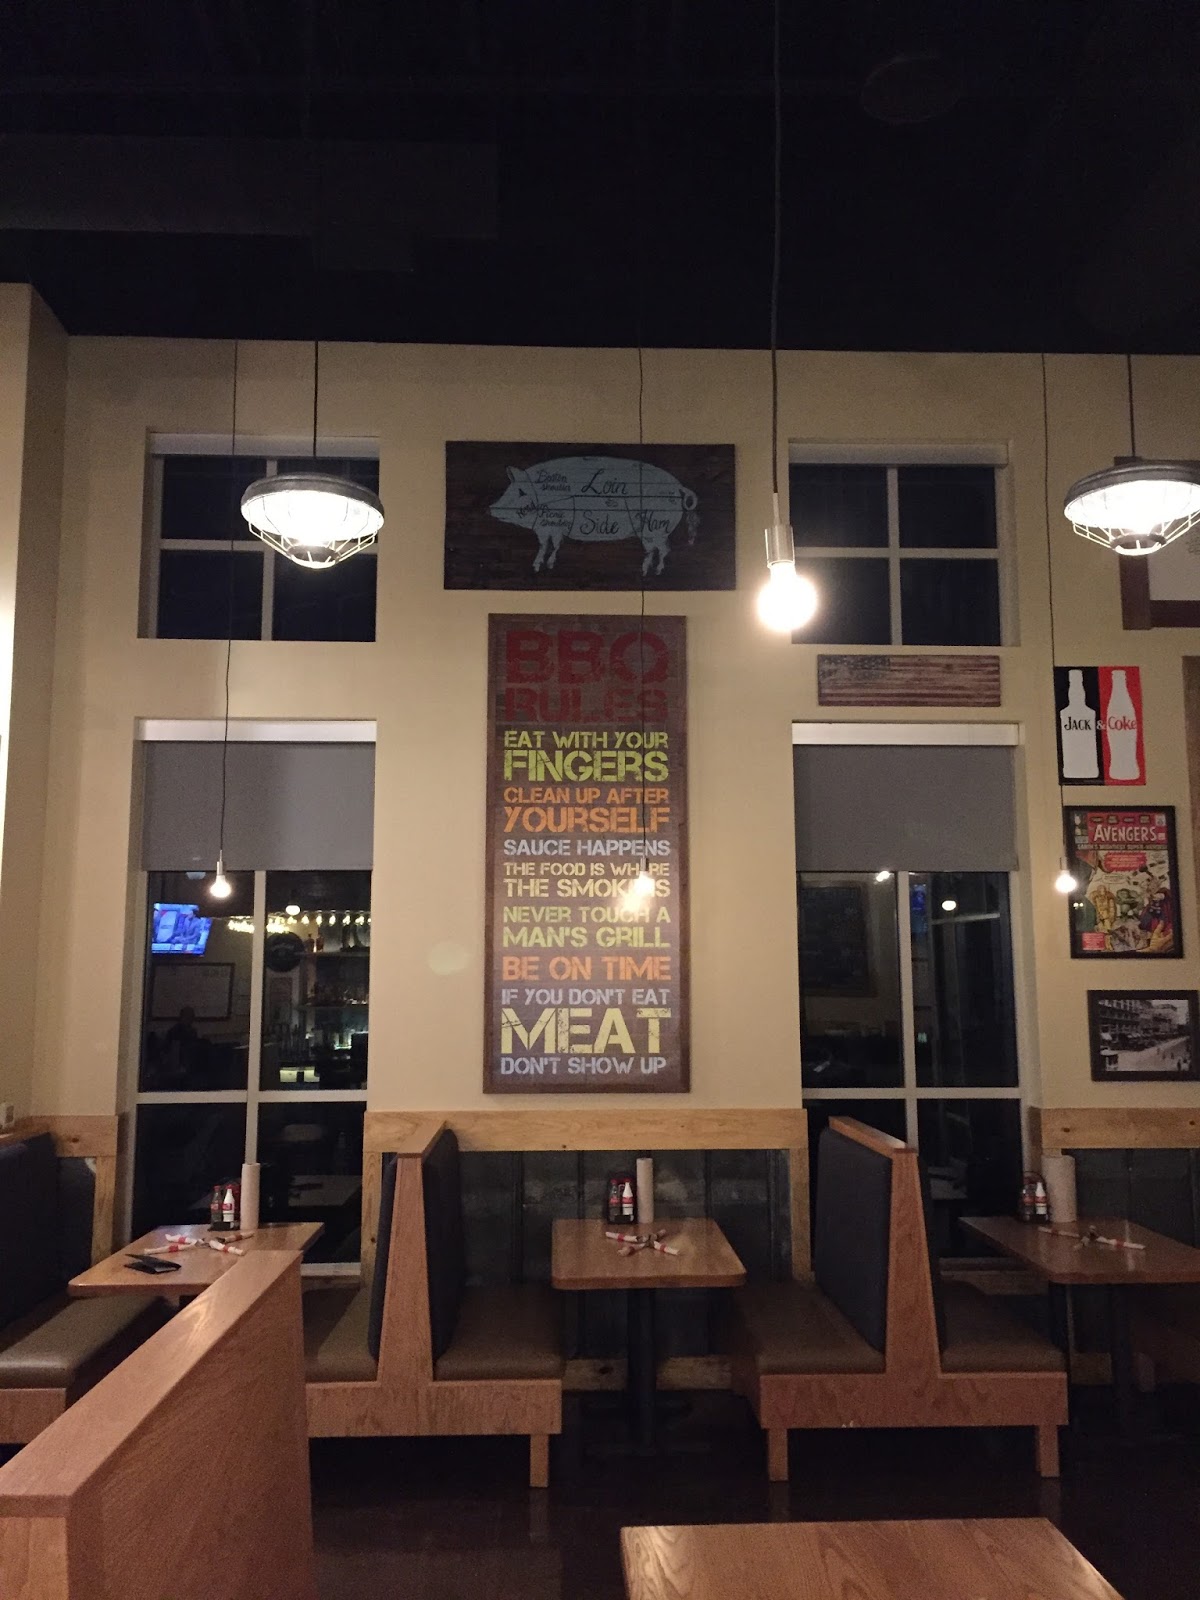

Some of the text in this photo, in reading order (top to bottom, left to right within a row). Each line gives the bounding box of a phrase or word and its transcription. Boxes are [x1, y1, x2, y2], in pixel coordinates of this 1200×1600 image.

[581, 468, 627, 494] Loin
[580, 510, 619, 535] Side
[635, 509, 670, 533] Ham
[506, 630, 669, 684] BBQ
[505, 687, 669, 722] RULES
[1064, 716, 1092, 731] JACK
[1108, 715, 1137, 731] Coke
[504, 731, 669, 749] EAT WITH YOUR
[504, 750, 669, 782] FINGERS
[503, 787, 669, 804] CLEAN UP AFTER
[503, 806, 671, 833] YOURSELF
[1093, 824, 1157, 842] AVENGERS
[503, 839, 671, 857] SAUCE HAPPENS
[503, 862, 670, 876] THE FOOD IS WHRE
[502, 878, 549, 898] THE
[556, 878, 647, 898] SMOK
[502, 906, 671, 923] NEVER TOUCH A
[502, 926, 671, 948] MAN'S GRILL
[502, 955, 672, 981] BE ON TIME
[501, 988, 671, 1005] IF YOU DON'T EAT
[501, 1007, 672, 1054] MEAT
[500, 1056, 667, 1075] DON'T SHOW UP
